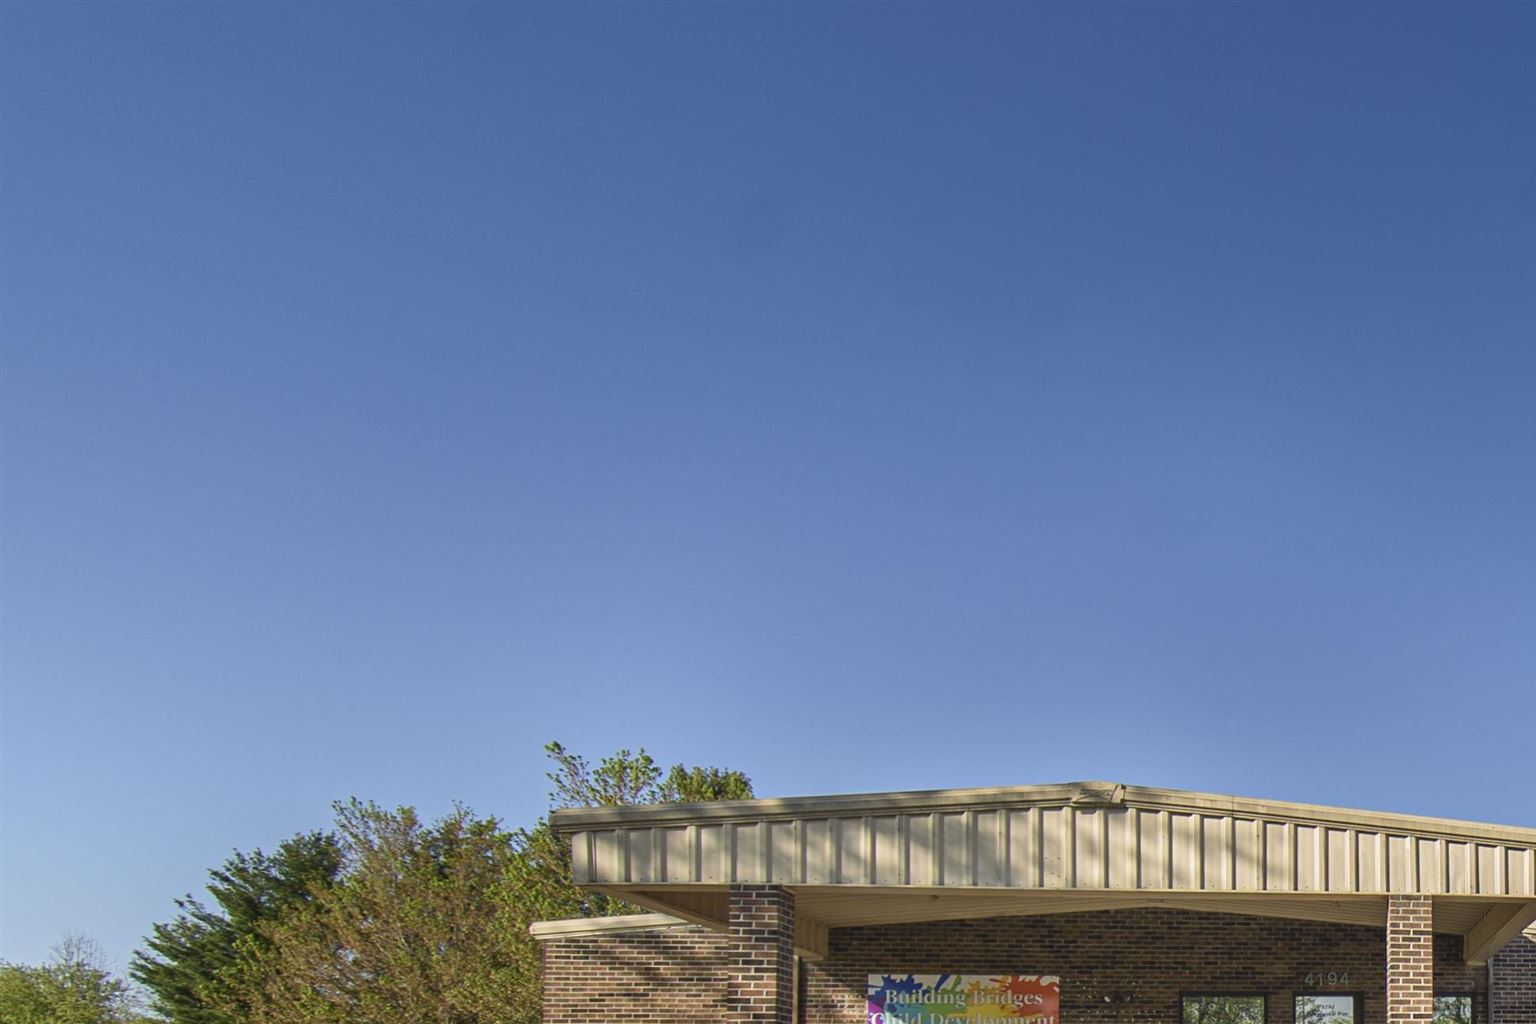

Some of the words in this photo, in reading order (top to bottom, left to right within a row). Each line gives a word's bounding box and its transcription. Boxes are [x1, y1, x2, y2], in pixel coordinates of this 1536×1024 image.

[1304, 971, 1350, 986] 4194
[885, 989, 966, 1008] Building
[973, 990, 1044, 1008] Bridges
